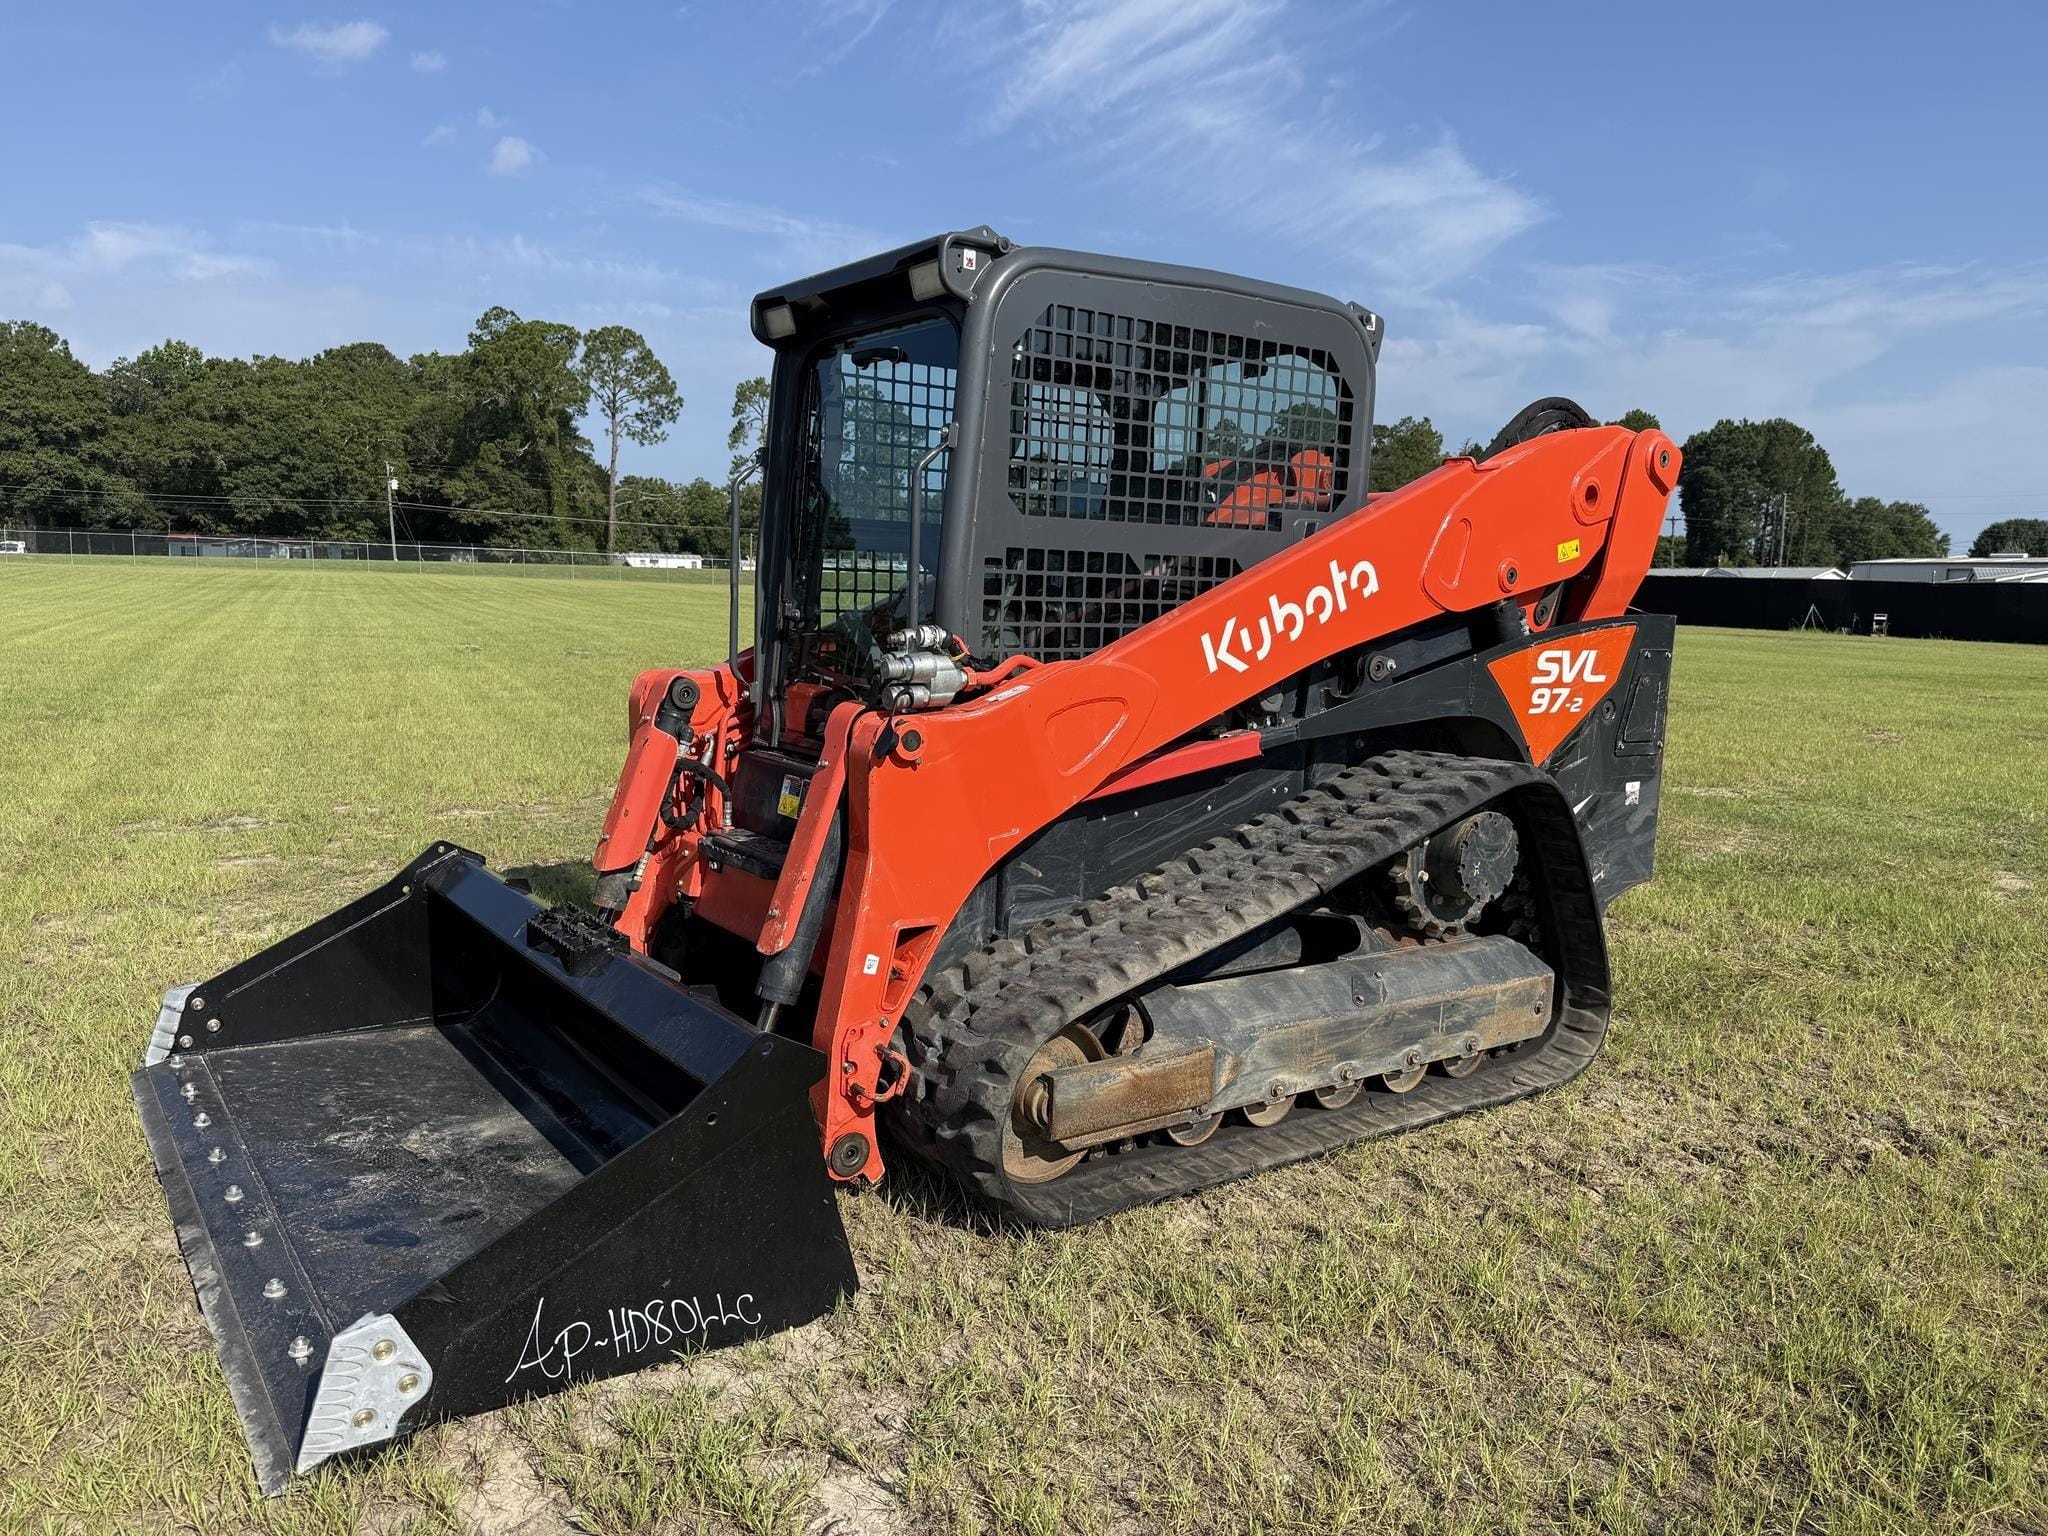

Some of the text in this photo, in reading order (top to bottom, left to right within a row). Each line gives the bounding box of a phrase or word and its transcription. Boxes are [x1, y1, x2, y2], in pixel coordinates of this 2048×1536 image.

[1200, 560, 1379, 674] Kubota
[1531, 650, 1607, 684] SVL
[1528, 688, 1583, 715] 97-2
